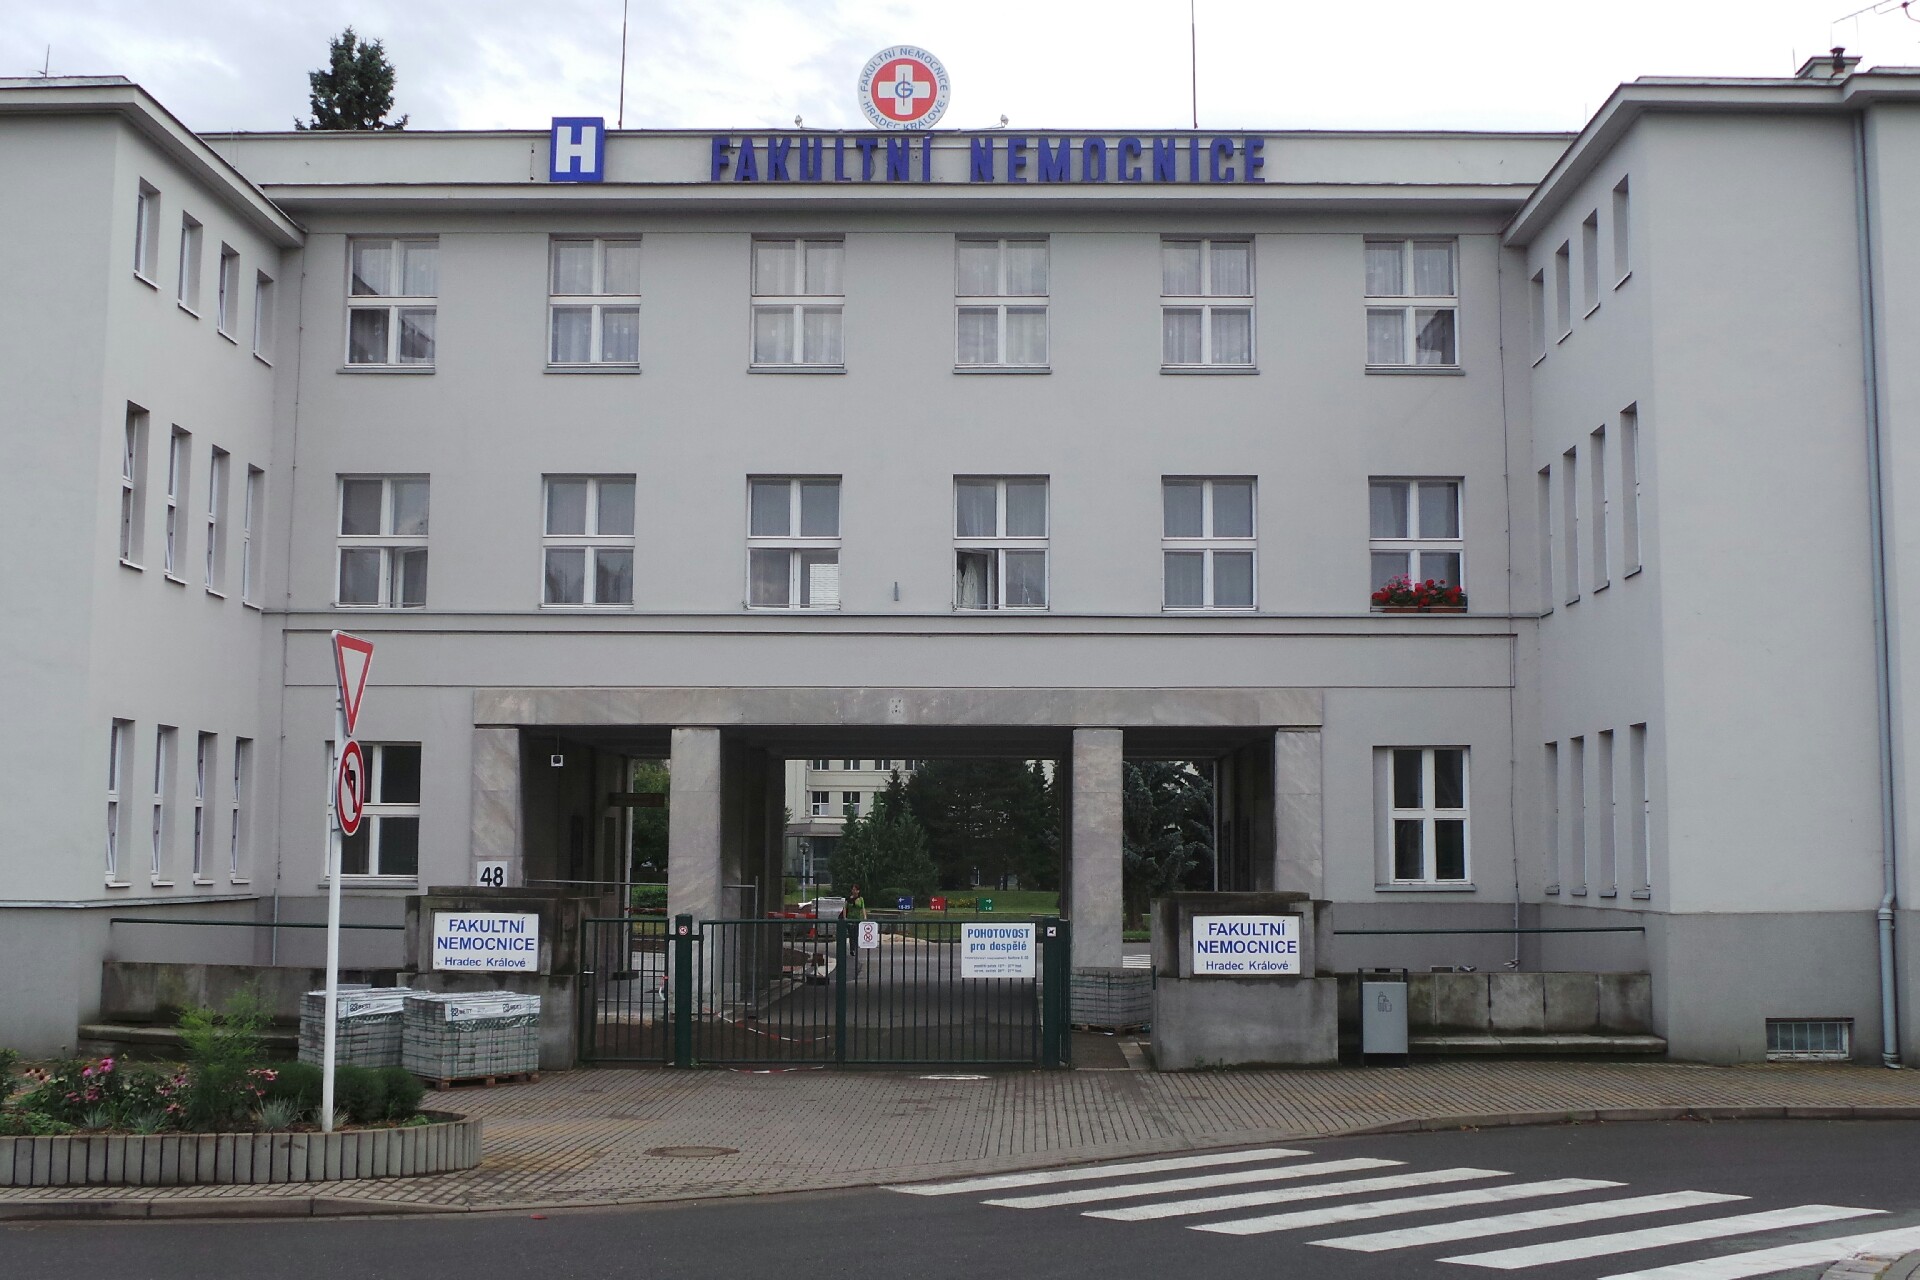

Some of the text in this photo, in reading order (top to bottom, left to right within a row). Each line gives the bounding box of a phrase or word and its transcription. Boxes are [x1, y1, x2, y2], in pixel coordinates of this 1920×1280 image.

[860, 47, 948, 92] FAKULTNÍ NEMOCNICE
[555, 126, 597, 173] H
[711, 133, 1266, 183] FAKULTNÍ NEMOCNICE
[480, 866, 504, 887] 48
[449, 917, 525, 933] FAKULTNÍ
[1208, 919, 1286, 936] FAKULTNÍ
[967, 928, 1030, 939] POHOTOVOST
[437, 937, 535, 951] NEMOCNICE
[970, 940, 1027, 953] pro dospělé
[1197, 940, 1297, 954] NEMOCNICE
[444, 956, 526, 968] Hradec Králové
[1206, 960, 1289, 971] Hradec Králové
